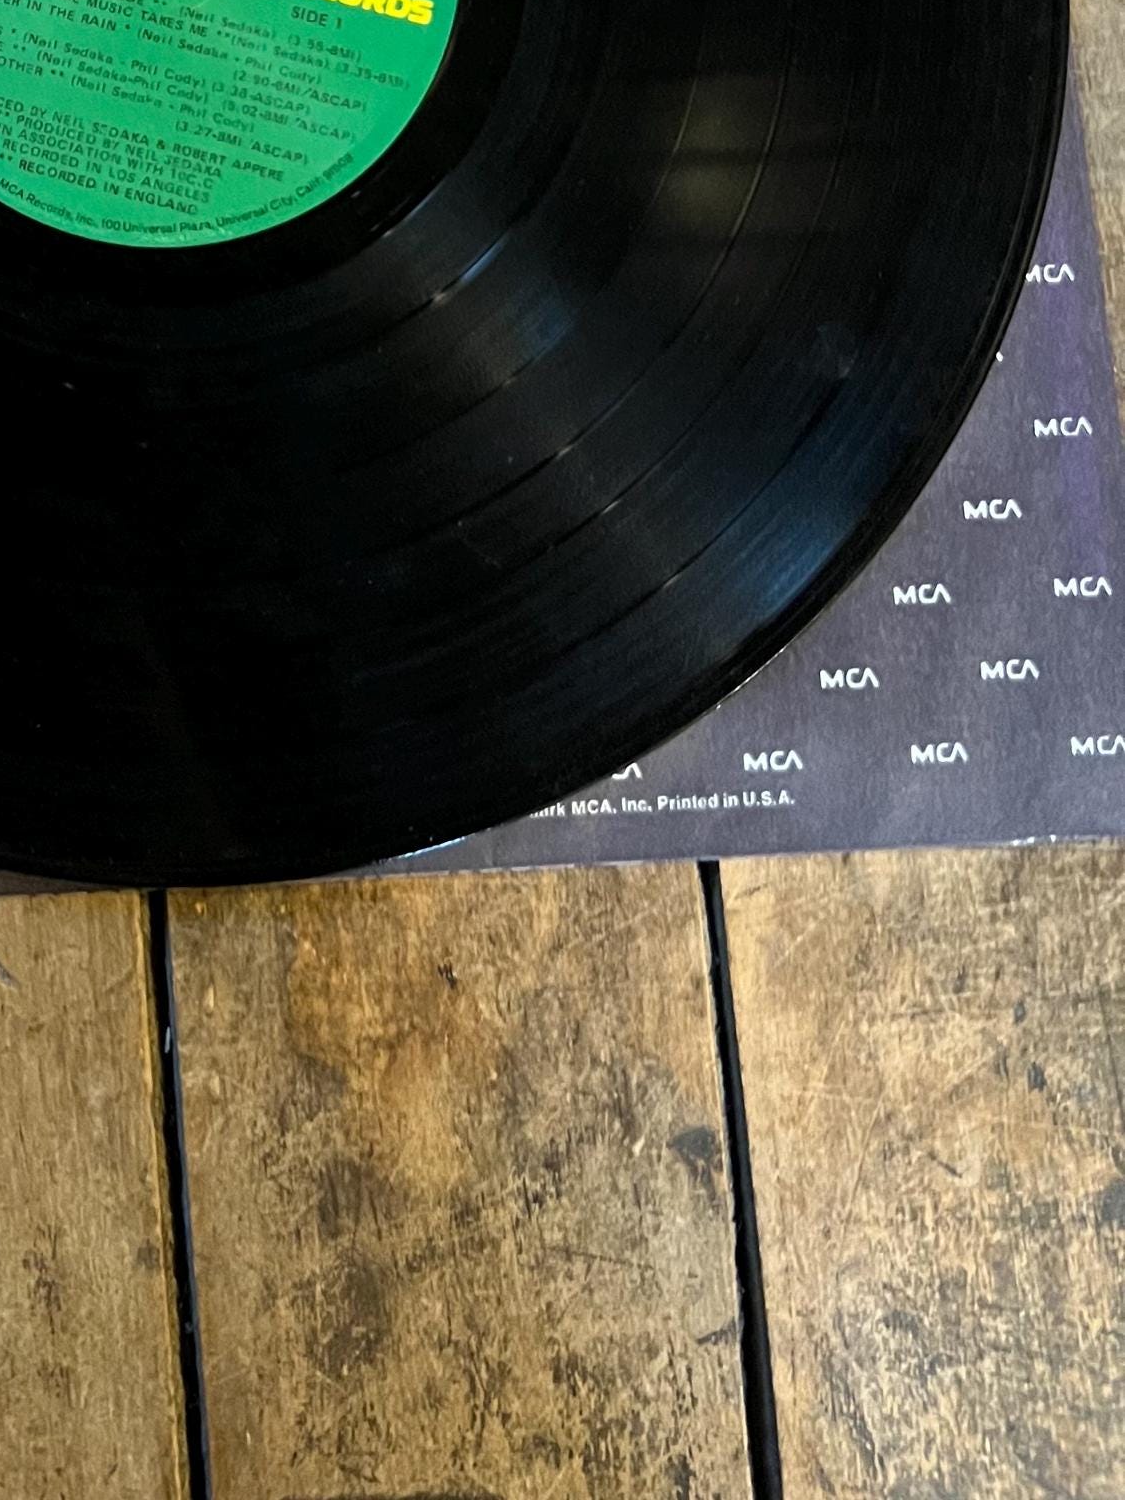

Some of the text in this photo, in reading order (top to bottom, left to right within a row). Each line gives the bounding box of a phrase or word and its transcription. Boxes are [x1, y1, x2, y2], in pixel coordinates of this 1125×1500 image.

[26, 0, 42, 12] IN
[48, 4, 76, 21] THE
[80, 12, 117, 32] RAIN
[139, 9, 184, 31] TAKES
[188, 23, 208, 37] ME
[290, 5, 343, 30] SIDE 1
[63, 42, 114, 64] Sedaka
[15, 113, 98, 145] PRODUCED
[102, 137, 119, 151] BY
[123, 143, 160, 162] NEIL
[29, 104, 47, 118] BY
[51, 111, 86, 130] NEIL
[90, 121, 150, 146] SEDAKA
[171, 142, 227, 167] ROBERT
[231, 158, 284, 181] APPERE
[16, 128, 122, 165] ASSOCIATION
[125, 156, 164, 176] WITH
[1, 138, 211, 204] RECORDED IN LOS ANGELES
[17, 158, 199, 216] RECORDED IN ENGLAND
[0, 178, 24, 199] MCA
[101, 219, 121, 232] 100
[1034, 416, 1092, 437] MCA
[963, 499, 1022, 519] MCA
[893, 584, 951, 605] MCA
[1054, 577, 1112, 597] MCA
[820, 668, 879, 689] MCA
[981, 659, 1039, 680] MCA
[911, 742, 968, 764] MCA
[1071, 734, 1125, 756] MCA
[744, 750, 803, 771] MCA
[657, 792, 718, 812] Printed
[723, 792, 739, 809] in
[742, 789, 795, 808] U.S.A.
